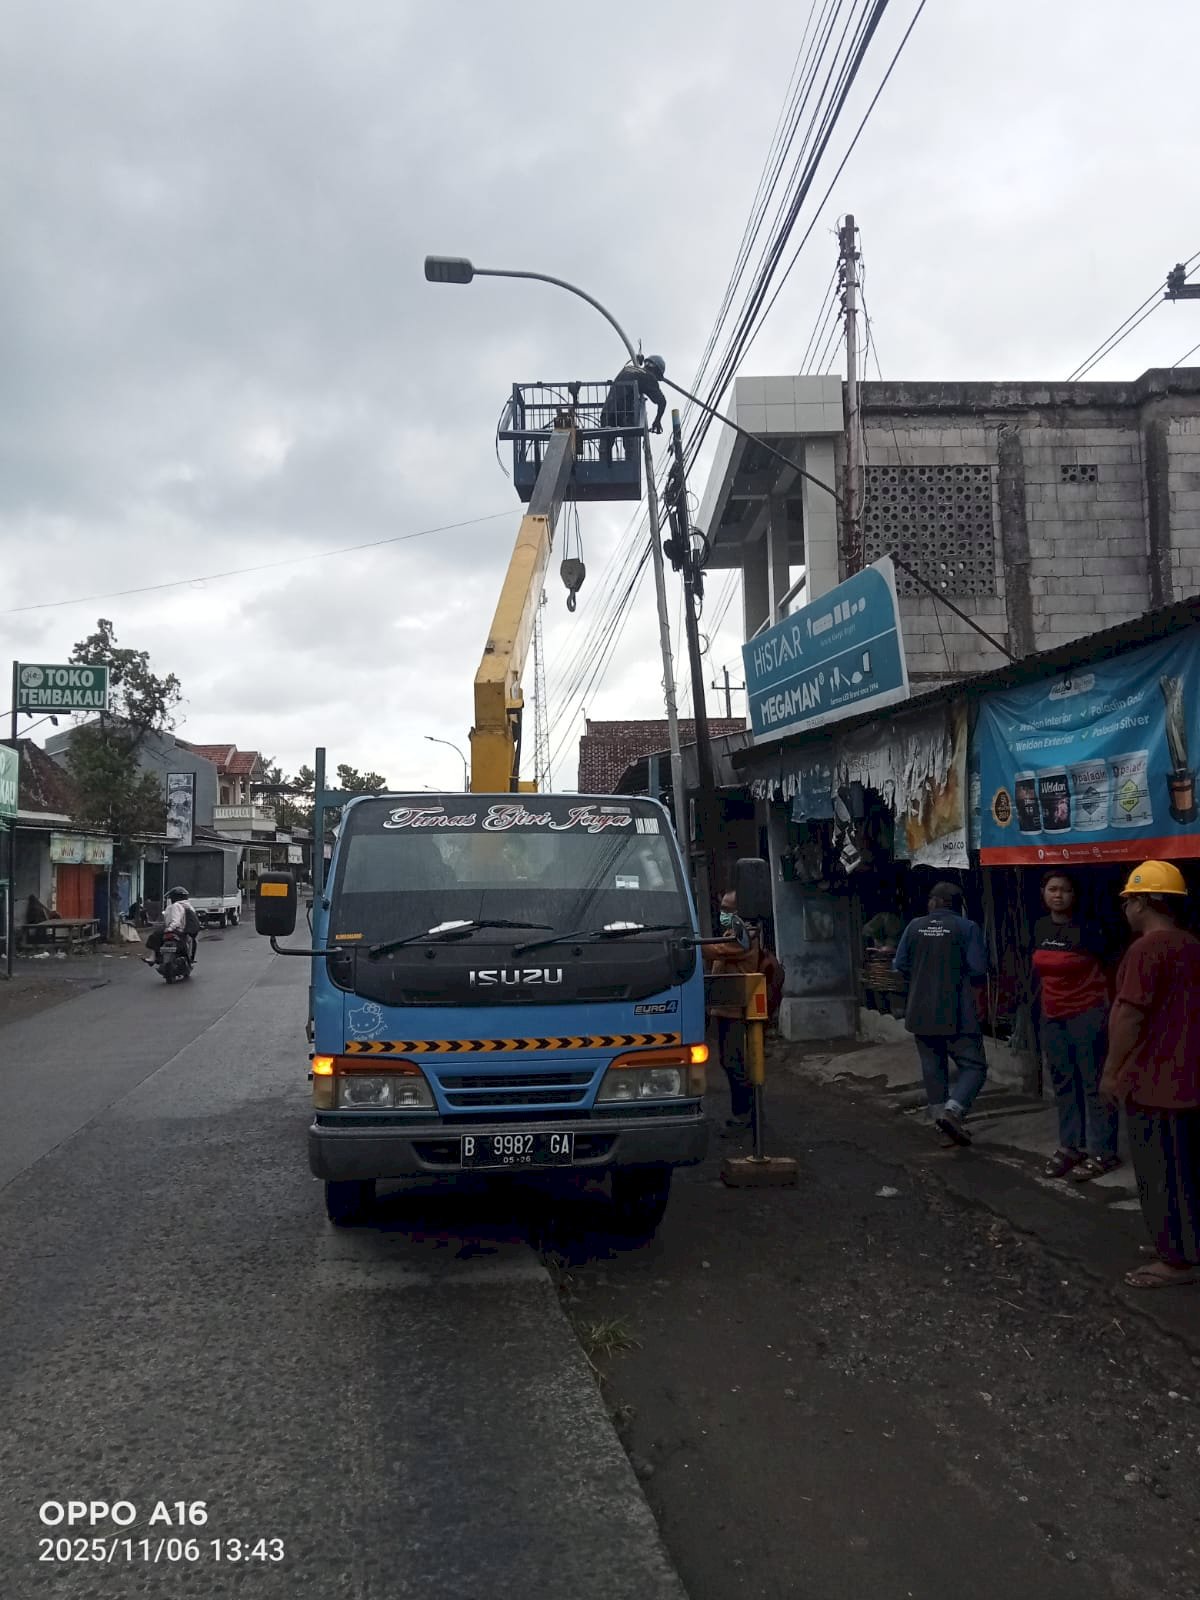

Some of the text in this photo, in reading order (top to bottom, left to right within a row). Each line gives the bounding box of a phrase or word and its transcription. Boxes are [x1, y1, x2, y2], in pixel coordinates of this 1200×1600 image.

[46, 669, 94, 688] TOKO
[20, 688, 105, 706] TEMBAKAU
[1044, 712, 1073, 728] Interior
[1120, 714, 1150, 730] Silver
[1015, 734, 1074, 752] Weldon Exterior
[1040, 781, 1067, 794] Weldon
[383, 806, 476, 829] Tunas
[549, 804, 633, 834] Jaya
[469, 968, 563, 986] ISUZU
[464, 1133, 570, 1156] B 9982 GA
